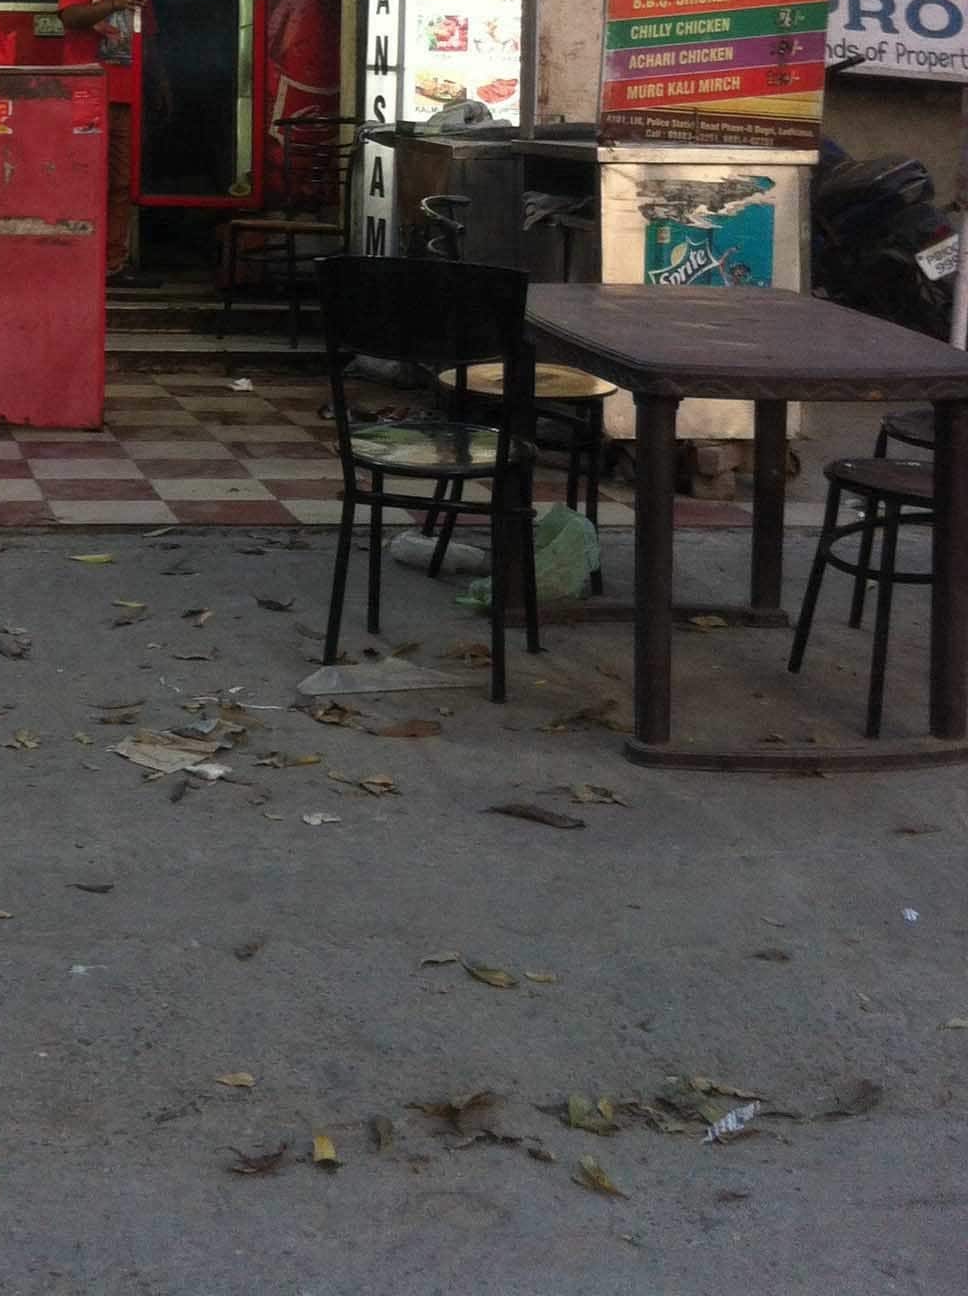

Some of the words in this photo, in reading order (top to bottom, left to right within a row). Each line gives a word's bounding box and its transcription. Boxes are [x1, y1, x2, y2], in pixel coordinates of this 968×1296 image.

[630, 22, 671, 40] CHILLY
[675, 16, 731, 36] CHICKEN
[628, 53, 676, 70] ACHARI
[678, 46, 734, 65] CHICKEN
[864, 41, 889, 62] of
[626, 83, 664, 100] MURG
[667, 80, 695, 97] KALI
[698, 75, 741, 94] MIRCH
[645, 116, 670, 128] Police
[645, 128, 662, 138] Call
[659, 247, 708, 286] Sprite
